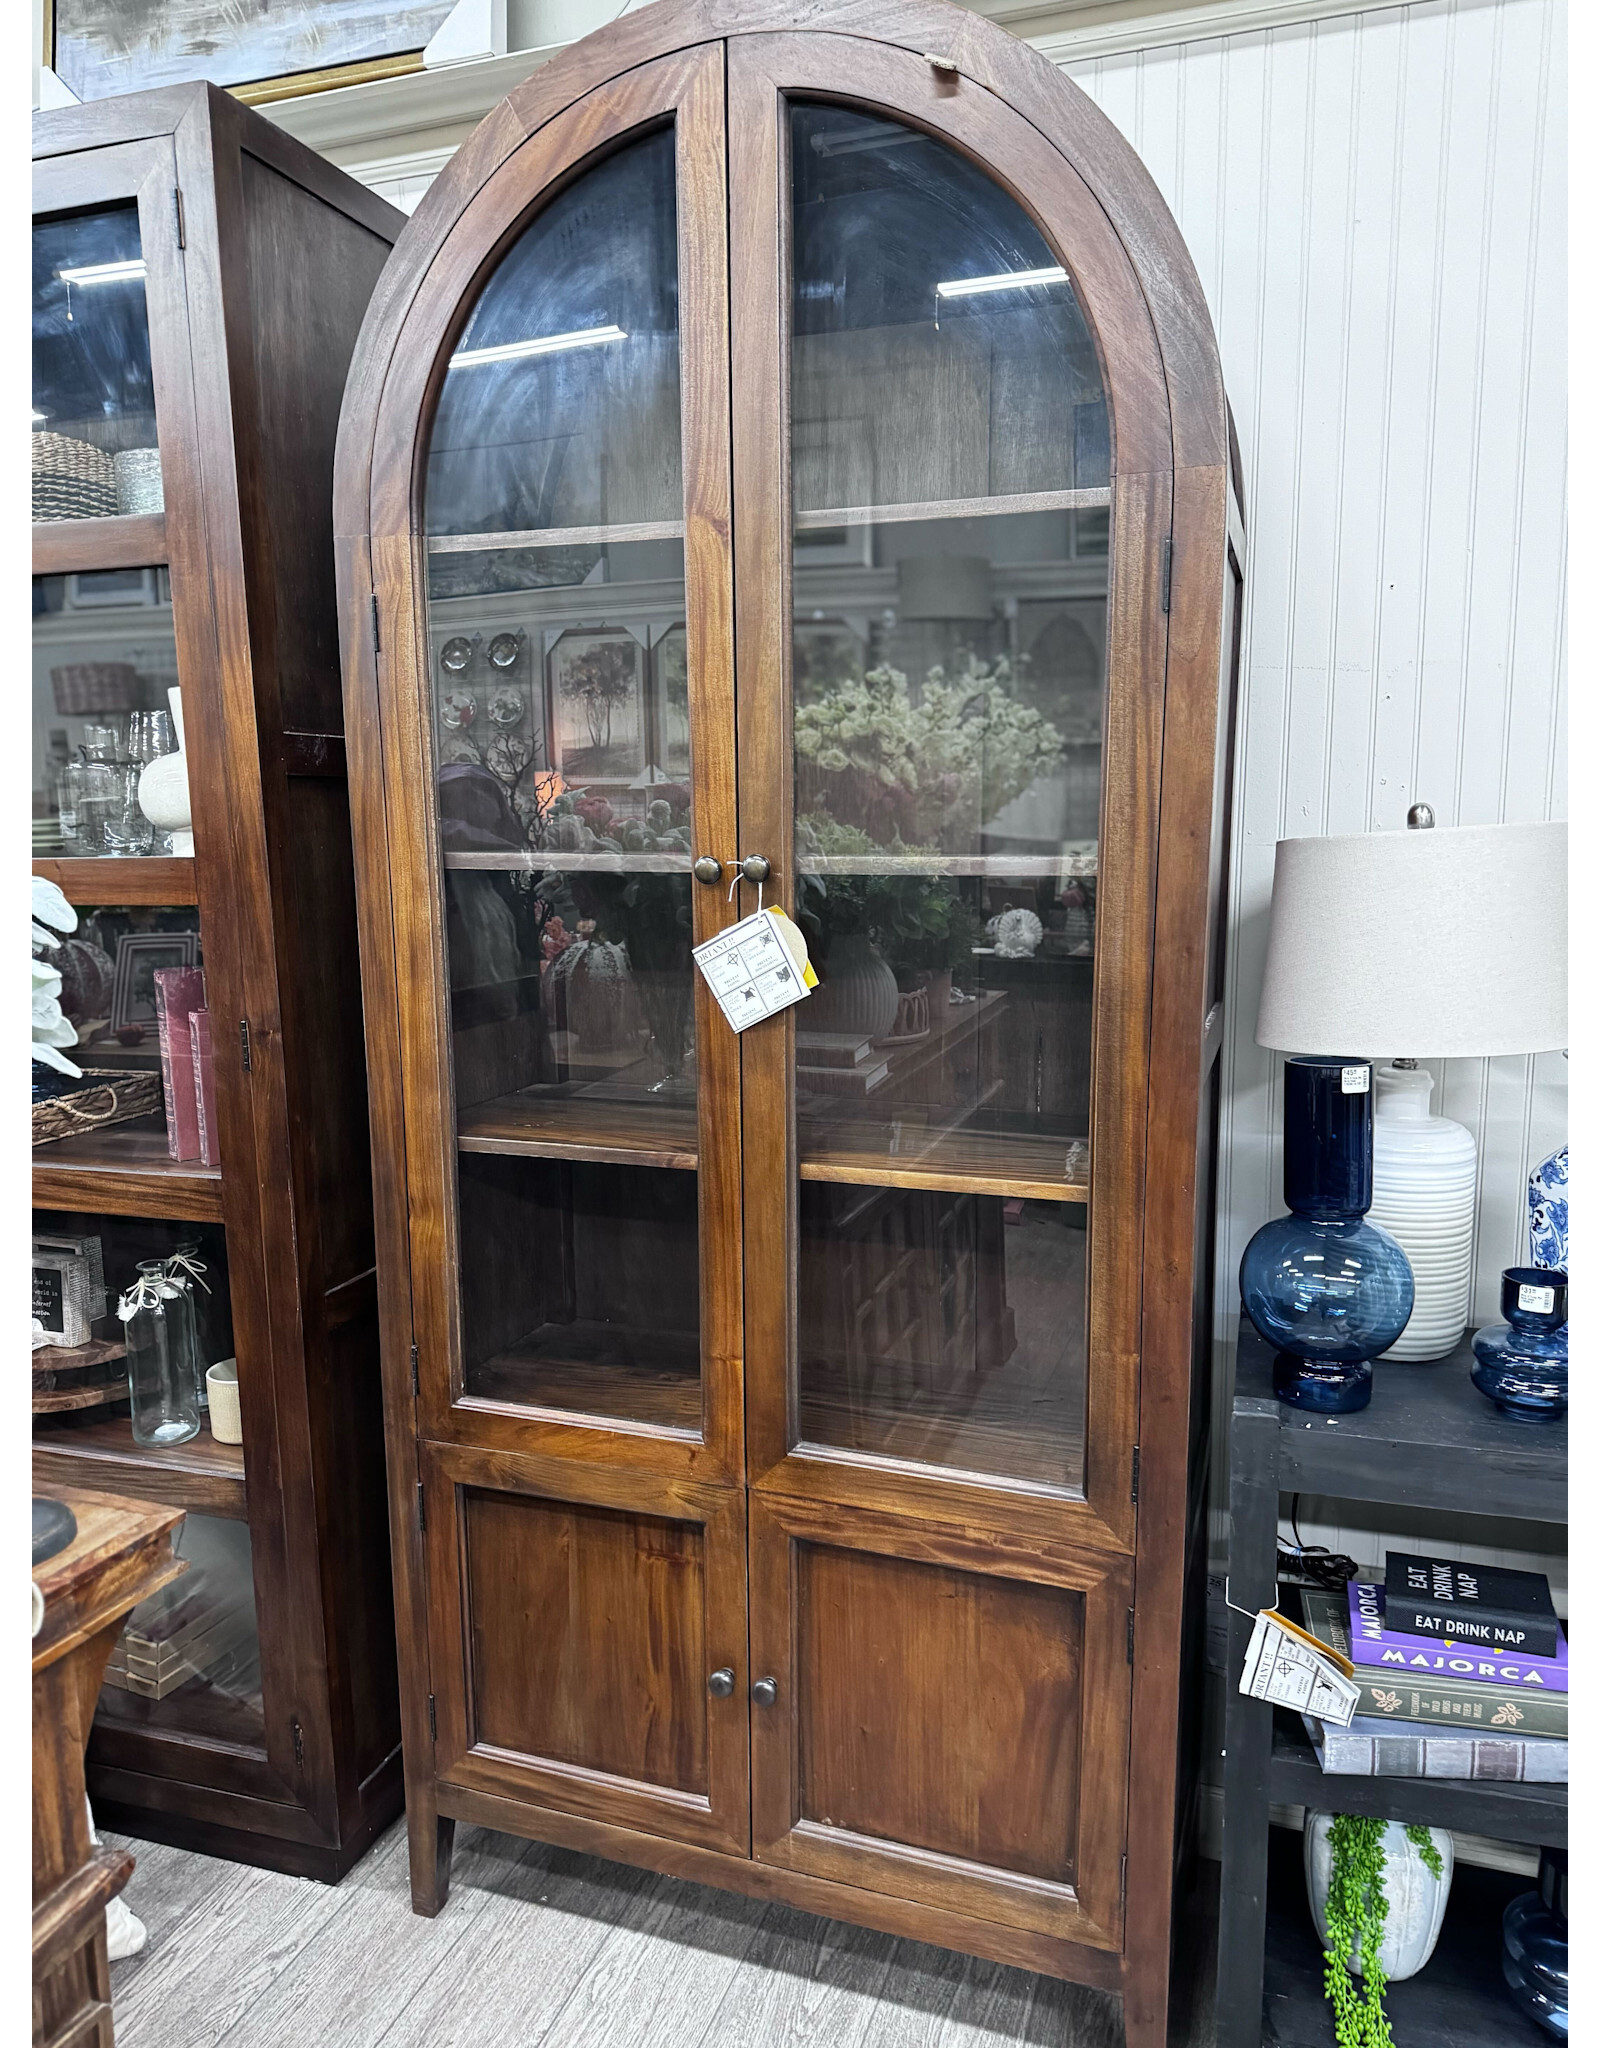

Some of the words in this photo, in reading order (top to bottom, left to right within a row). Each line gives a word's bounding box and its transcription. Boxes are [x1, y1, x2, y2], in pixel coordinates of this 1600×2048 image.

[1408, 1566, 1428, 1589] EAT
[1432, 1564, 1454, 1601] DRINK
[1457, 1573, 1479, 1599] NAP
[1357, 1584, 1382, 1640] MAJORCA
[1415, 1614, 1442, 1630] EAT
[1446, 1620, 1490, 1639] DRINK
[1494, 1627, 1526, 1645] NAP
[1329, 1620, 1350, 1658] IELDBOOK
[1381, 1649, 1544, 1684] MAJORCA
